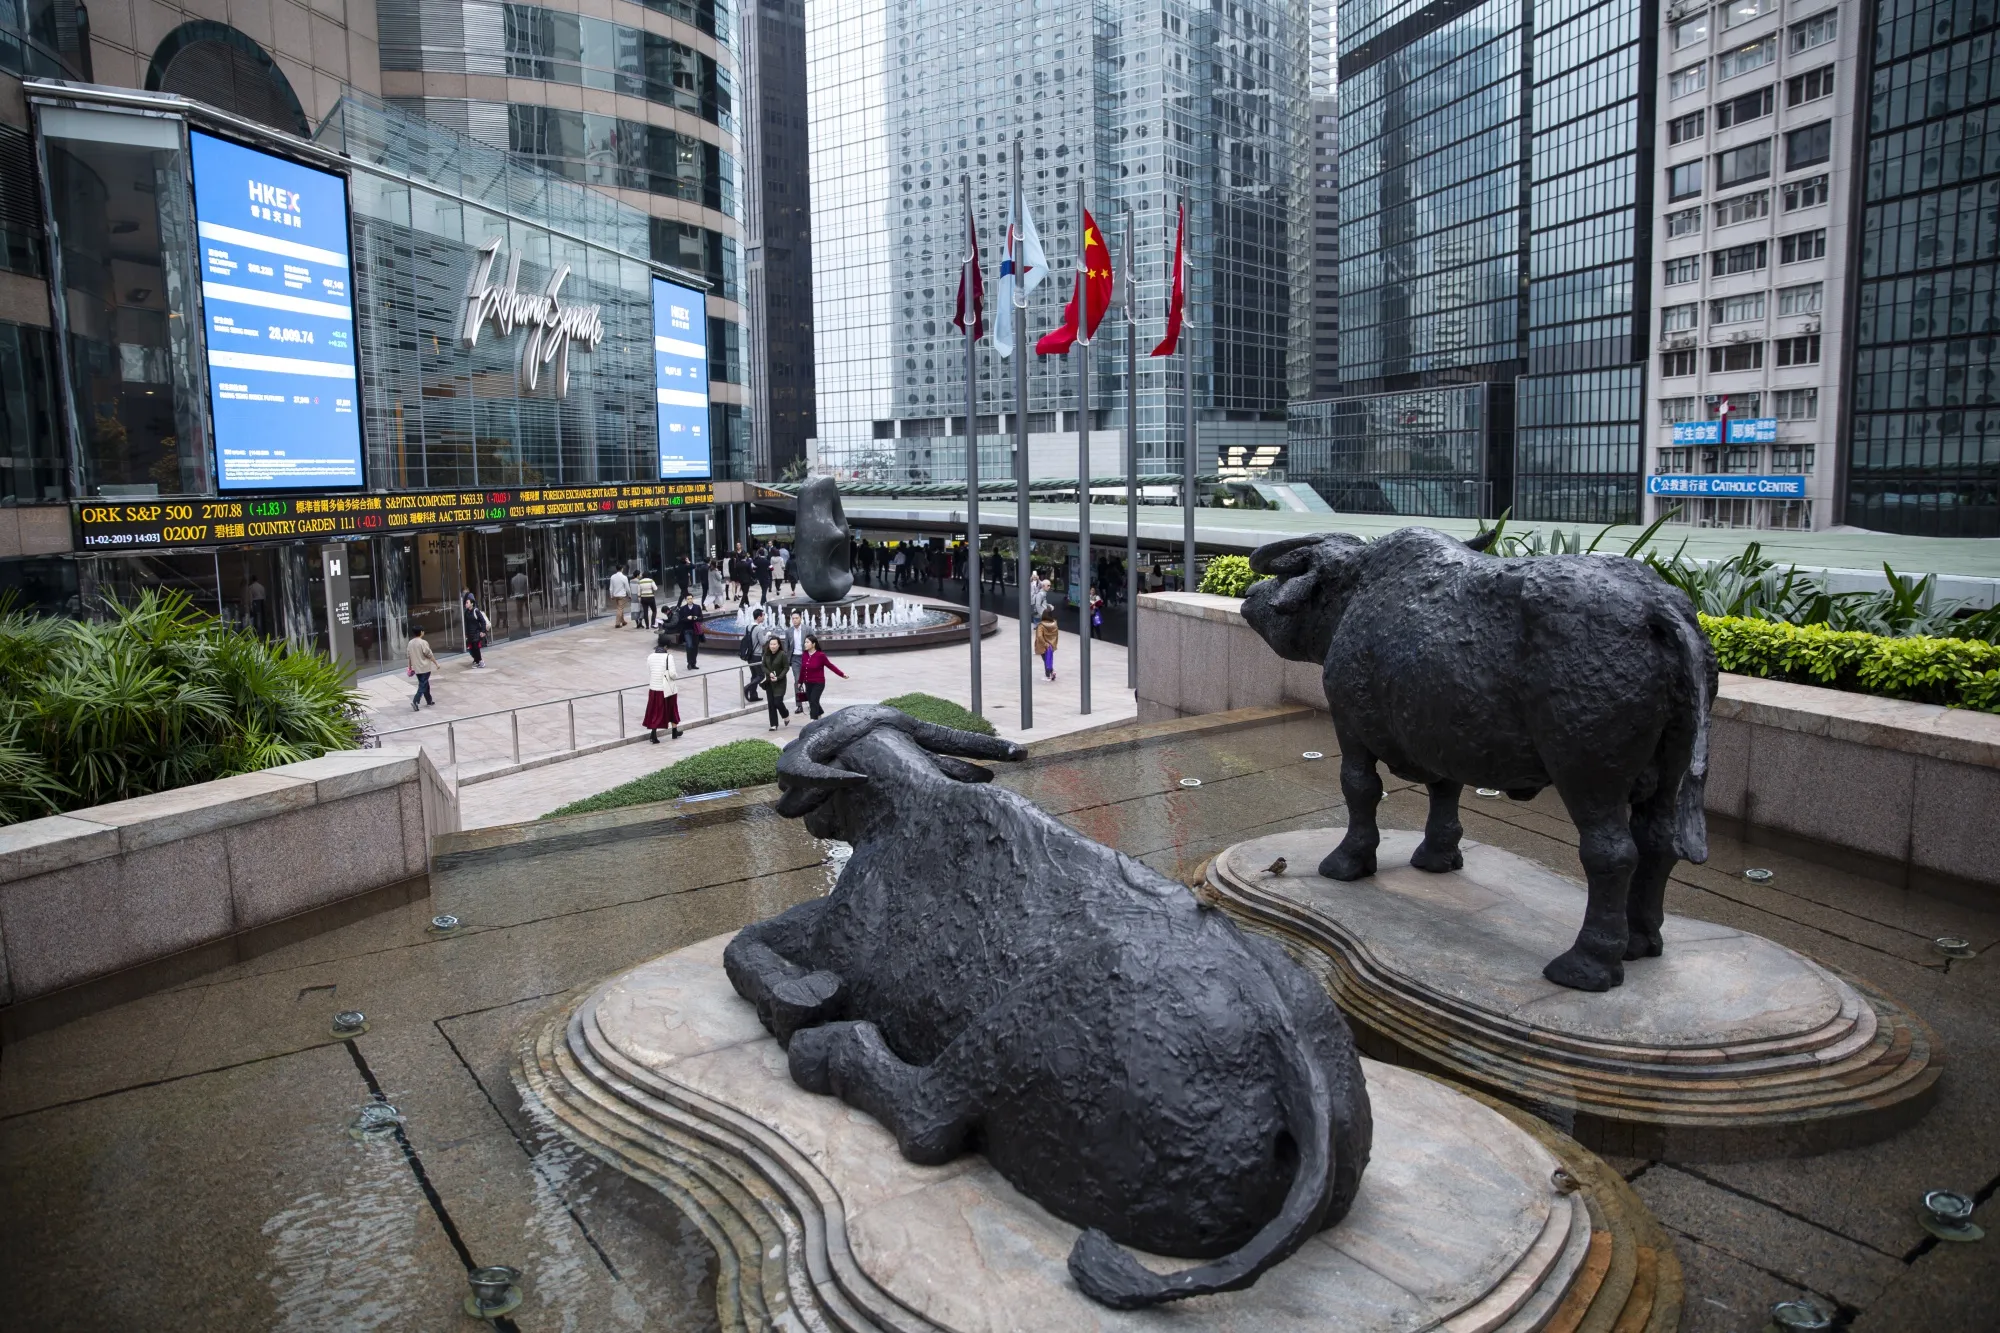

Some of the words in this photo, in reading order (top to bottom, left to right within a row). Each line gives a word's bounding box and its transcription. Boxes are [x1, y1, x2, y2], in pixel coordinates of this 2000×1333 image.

[248, 179, 301, 213] HKEX
[463, 236, 552, 390] Exchange
[540, 262, 604, 399] Square
[1673, 425, 1718, 441] 新生命堂
[1711, 480, 1757, 493] CATHOLIC
[1758, 480, 1799, 493] CENTRE
[82, 507, 122, 524] ORK
[126, 506, 162, 521] S&P
[165, 505, 193, 520] 500
[202, 504, 243, 519] 2707.88
[385, 496, 417, 509] S&P/TSX
[417, 494, 457, 508] COMPOSITE
[85, 534, 132, 545] 11-02-2019
[163, 526, 207, 541] 02007
[214, 523, 245, 539] 碧桂園
[248, 520, 296, 537] COUNTRY
[297, 517, 336, 533] GARDEN
[340, 516, 355, 530] 11.1
[388, 513, 408, 526] 02018
[438, 510, 453, 523] AAC
[453, 509, 472, 522] TECH
[473, 508, 485, 520] 51.0
[329, 559, 342, 577] H
